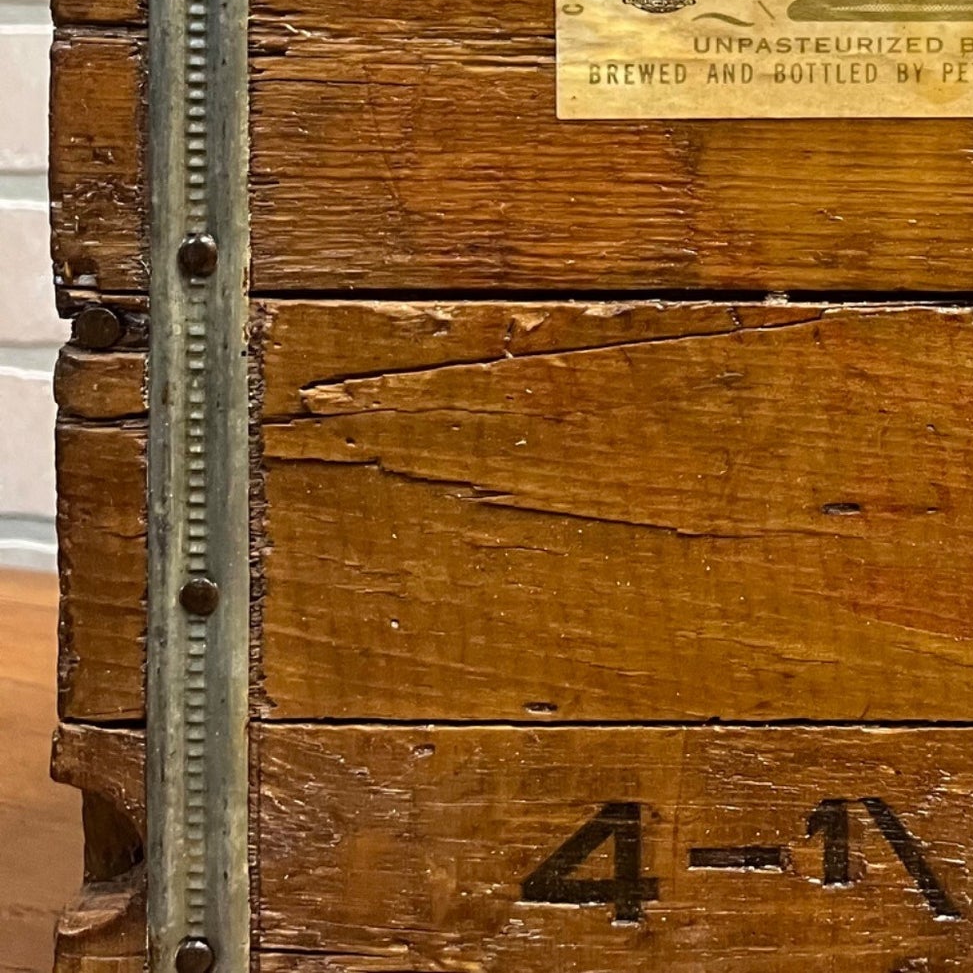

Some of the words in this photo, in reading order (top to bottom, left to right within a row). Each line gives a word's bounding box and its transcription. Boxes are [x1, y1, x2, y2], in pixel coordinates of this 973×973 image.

[693, 36, 944, 55] UNPASTEURIZED
[589, 62, 688, 85] BREWED
[706, 62, 754, 84] AND
[774, 62, 878, 84] BOTTLED
[897, 62, 923, 84] BY
